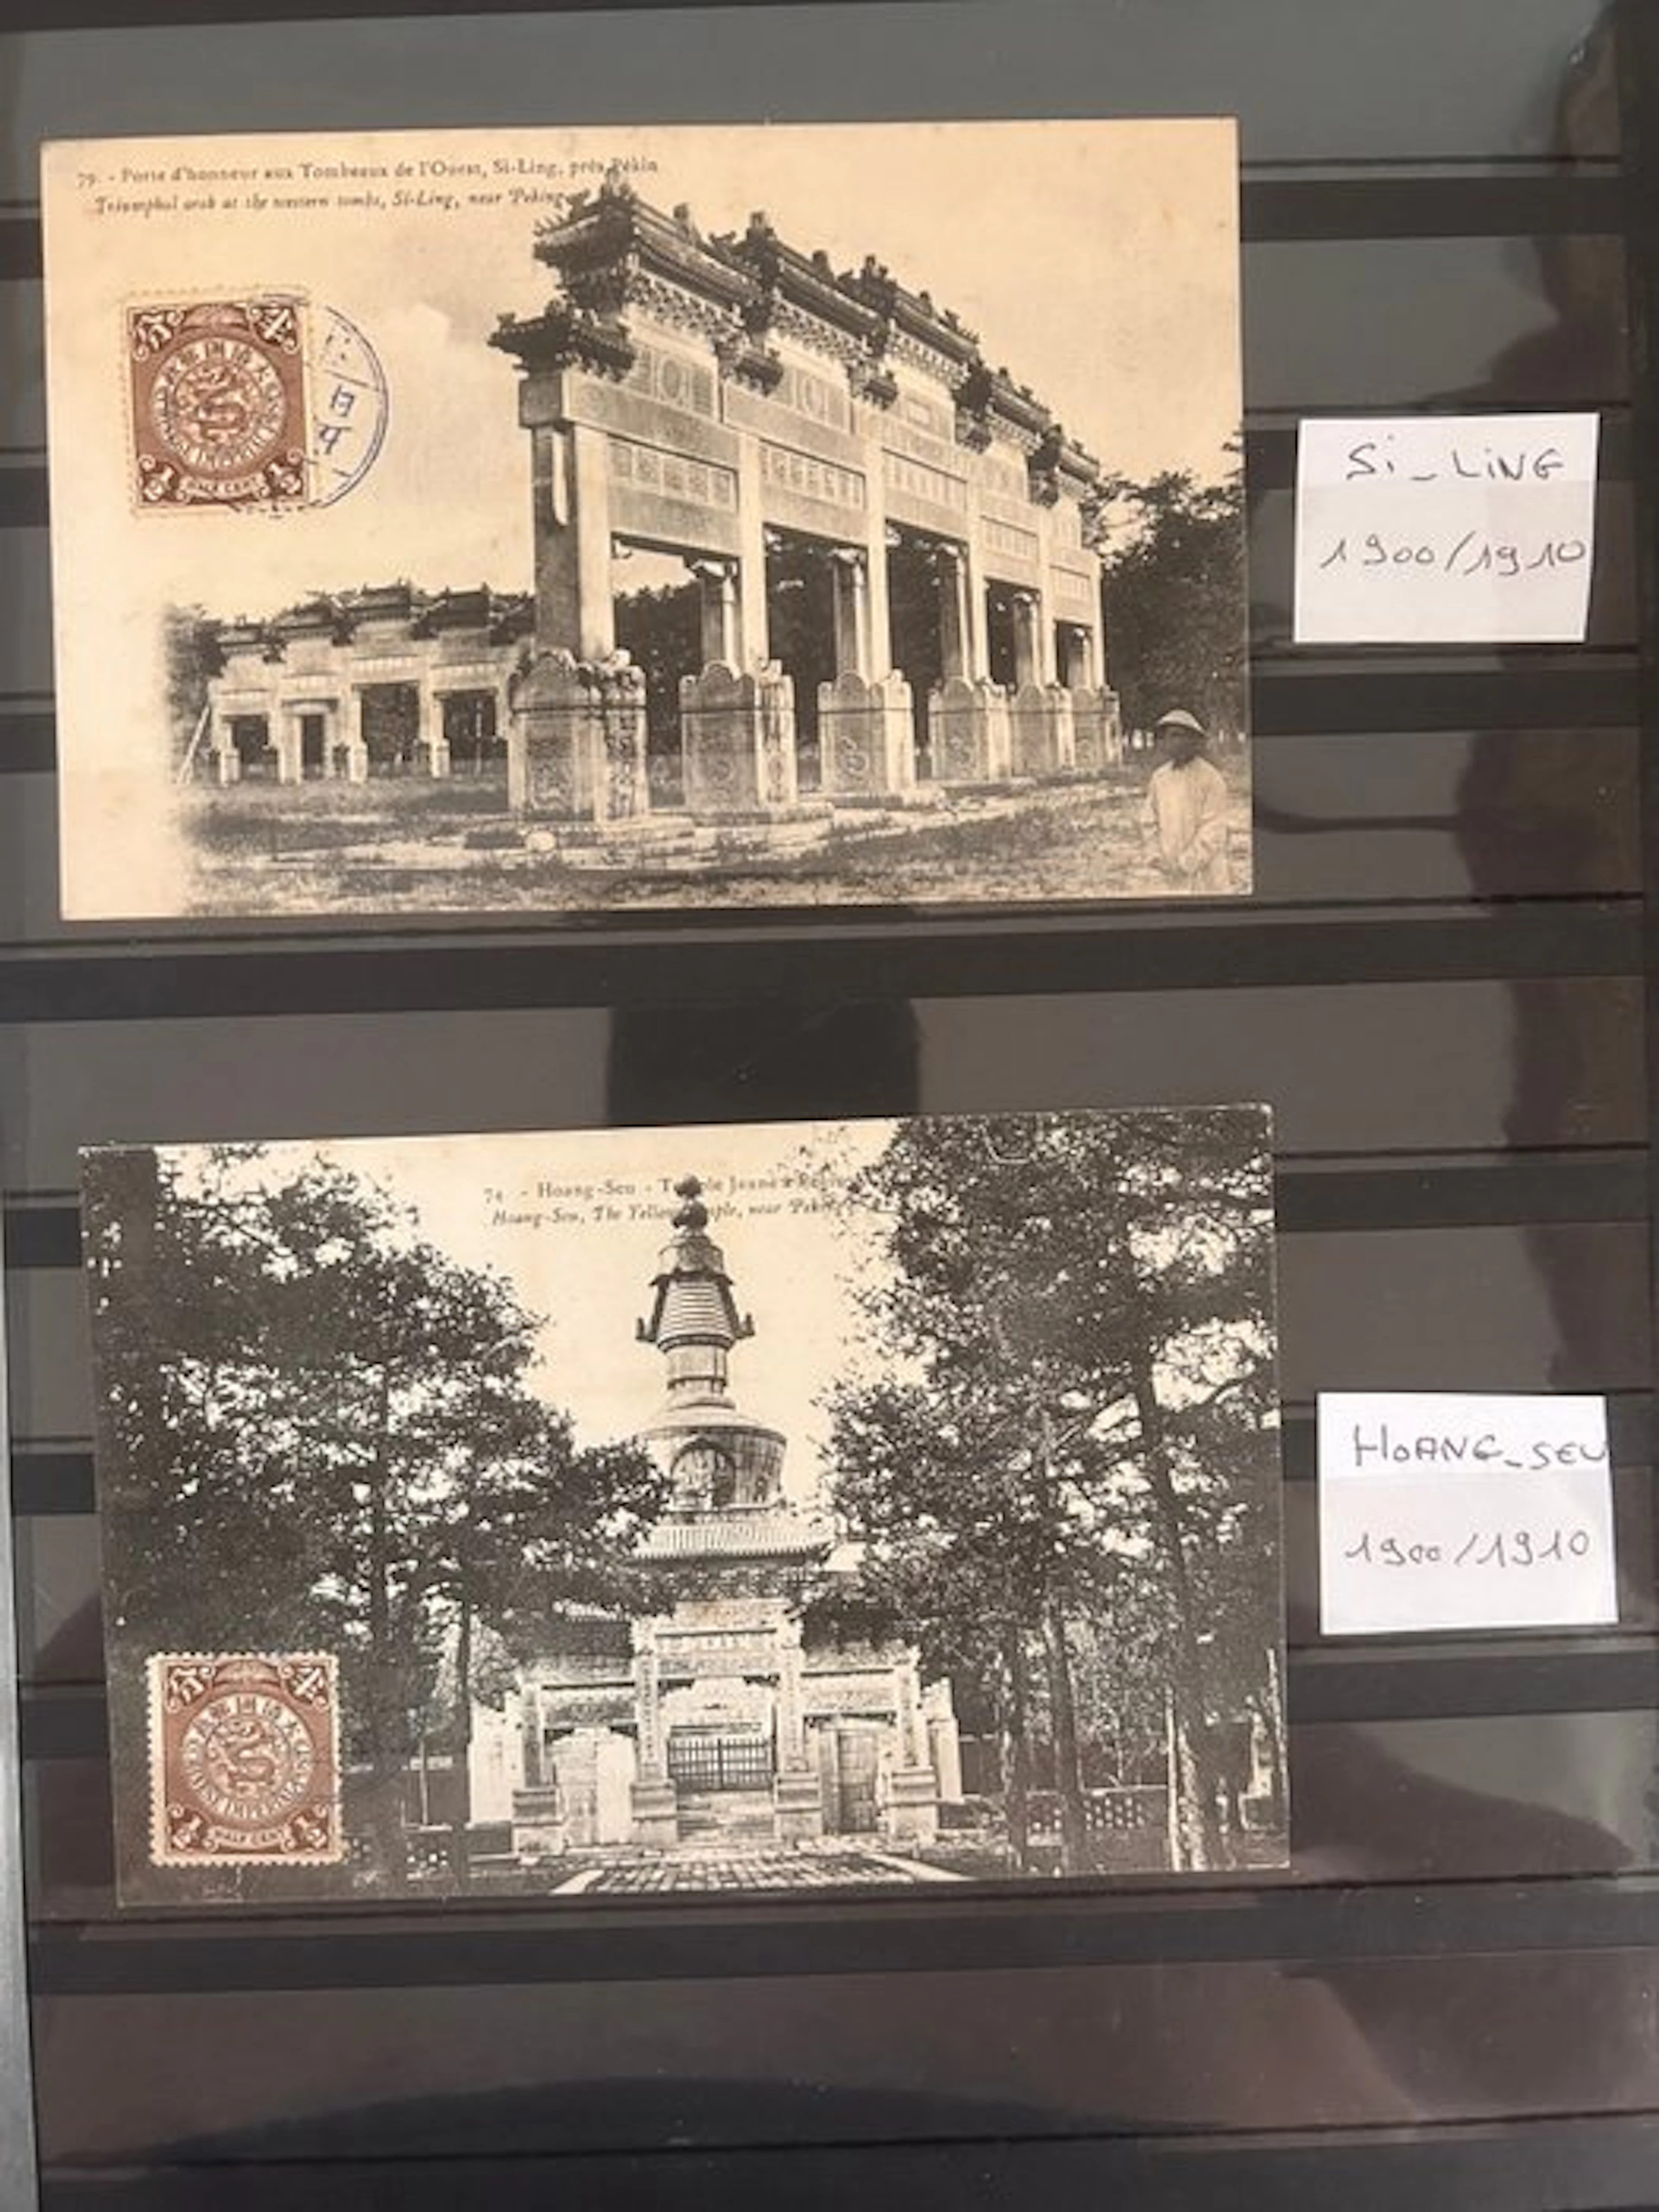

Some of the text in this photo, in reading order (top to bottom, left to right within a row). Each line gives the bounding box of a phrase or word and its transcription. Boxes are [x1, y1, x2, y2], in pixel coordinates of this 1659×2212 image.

[264, 168, 294, 179] aux
[298, 161, 387, 178] Tombeaux
[395, 161, 413, 177] de
[222, 197, 238, 209] at
[469, 193, 503, 203] near
